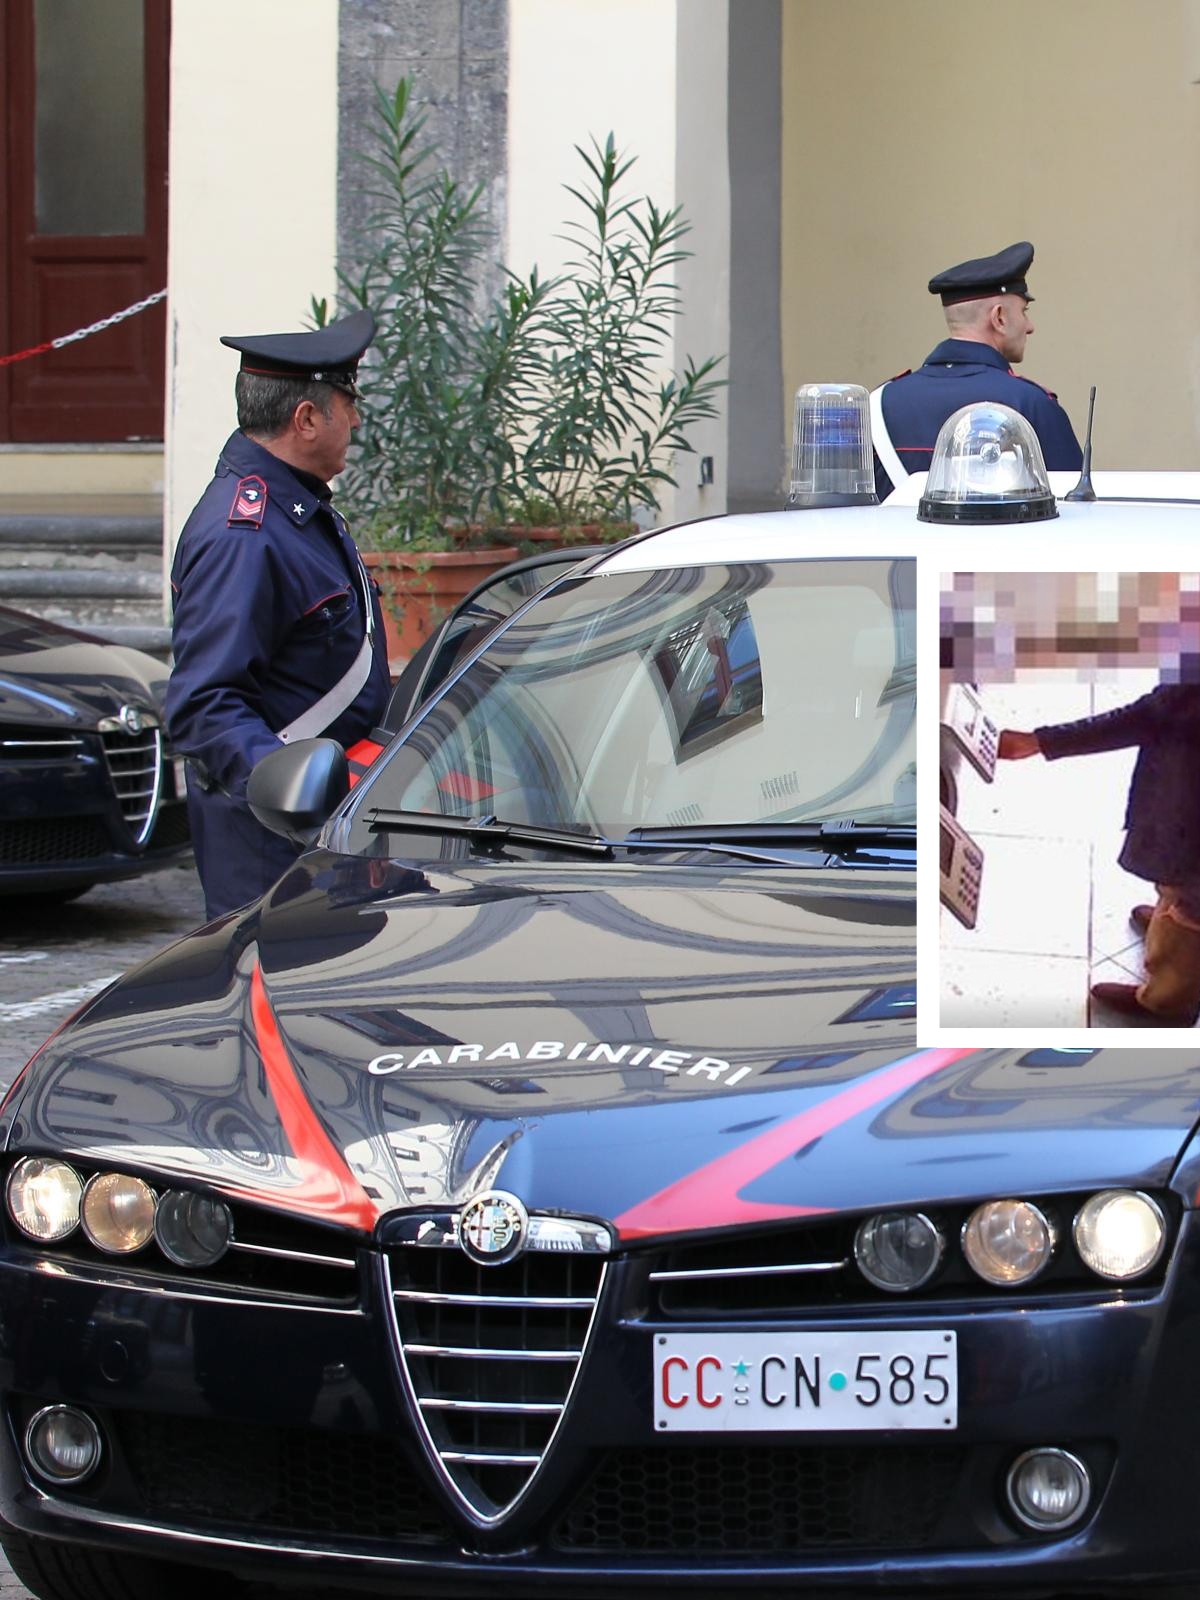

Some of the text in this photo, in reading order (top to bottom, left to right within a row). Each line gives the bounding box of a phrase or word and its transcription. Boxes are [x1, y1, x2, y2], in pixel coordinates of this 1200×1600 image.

[368, 1041, 752, 1086] CARABINIERI
[662, 1353, 950, 1409] CC CN 585
